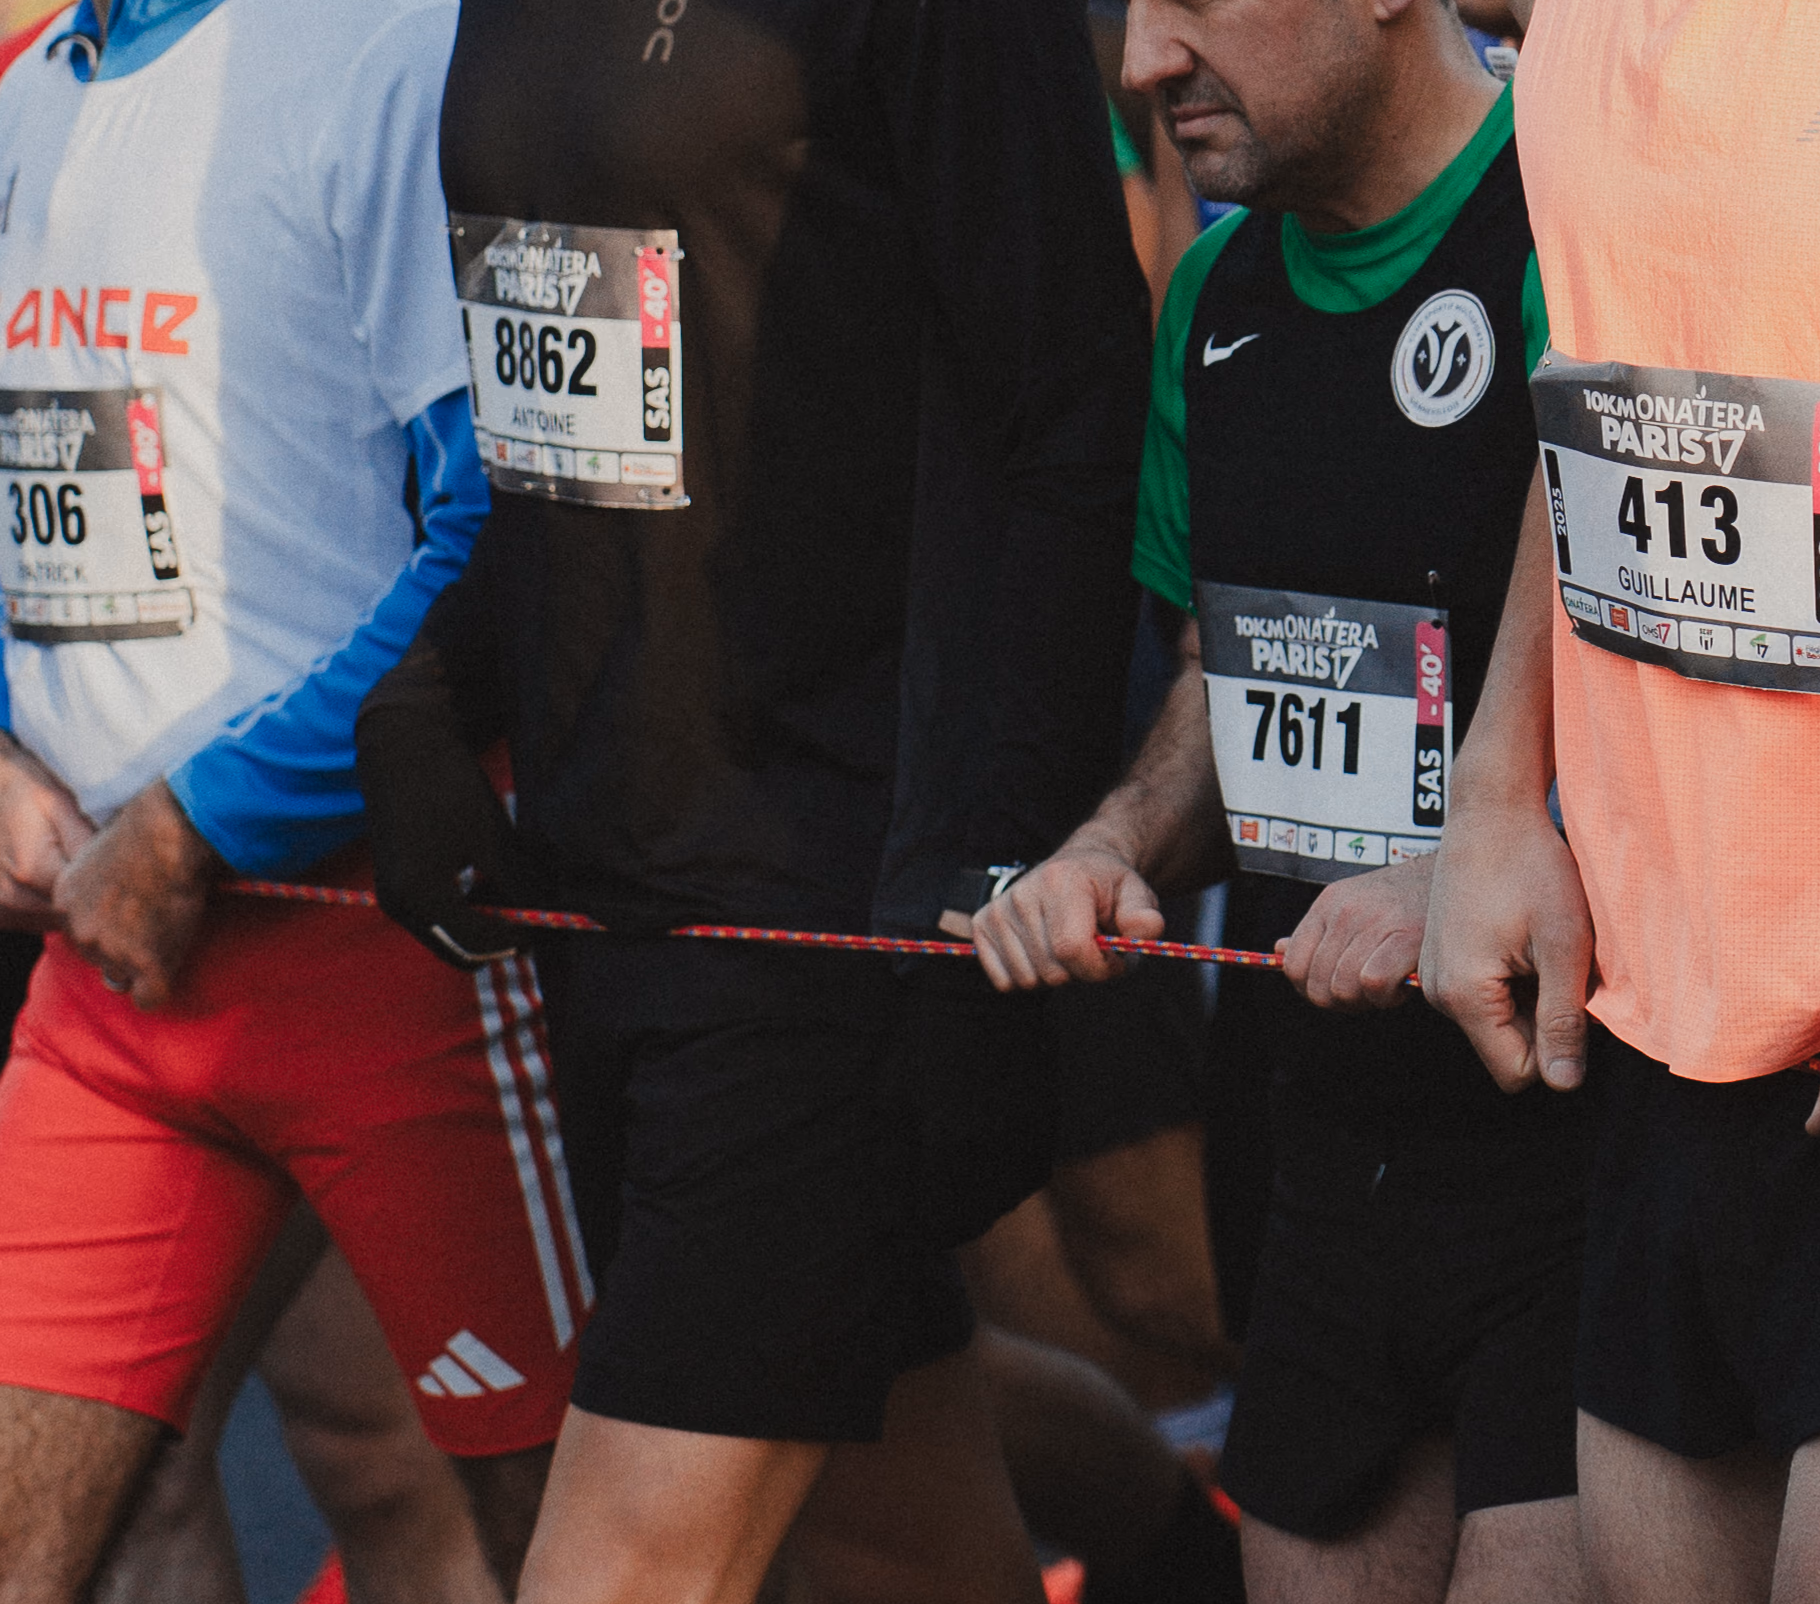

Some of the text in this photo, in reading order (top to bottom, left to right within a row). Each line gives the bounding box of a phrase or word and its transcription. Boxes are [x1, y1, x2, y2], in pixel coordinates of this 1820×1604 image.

[5, 287, 199, 355] ANCE
[495, 317, 598, 397] 8862
[512, 406, 577, 437] ANTOINE
[643, 366, 671, 430] SAS
[9, 481, 87, 546] 306
[144, 510, 179, 570] SAS
[1551, 486, 1568, 537] 2025
[1617, 475, 1743, 566] 413
[1617, 565, 1757, 614] GUILLAUME
[1245, 689, 1362, 775] 7611
[1417, 748, 1443, 812] SAS
